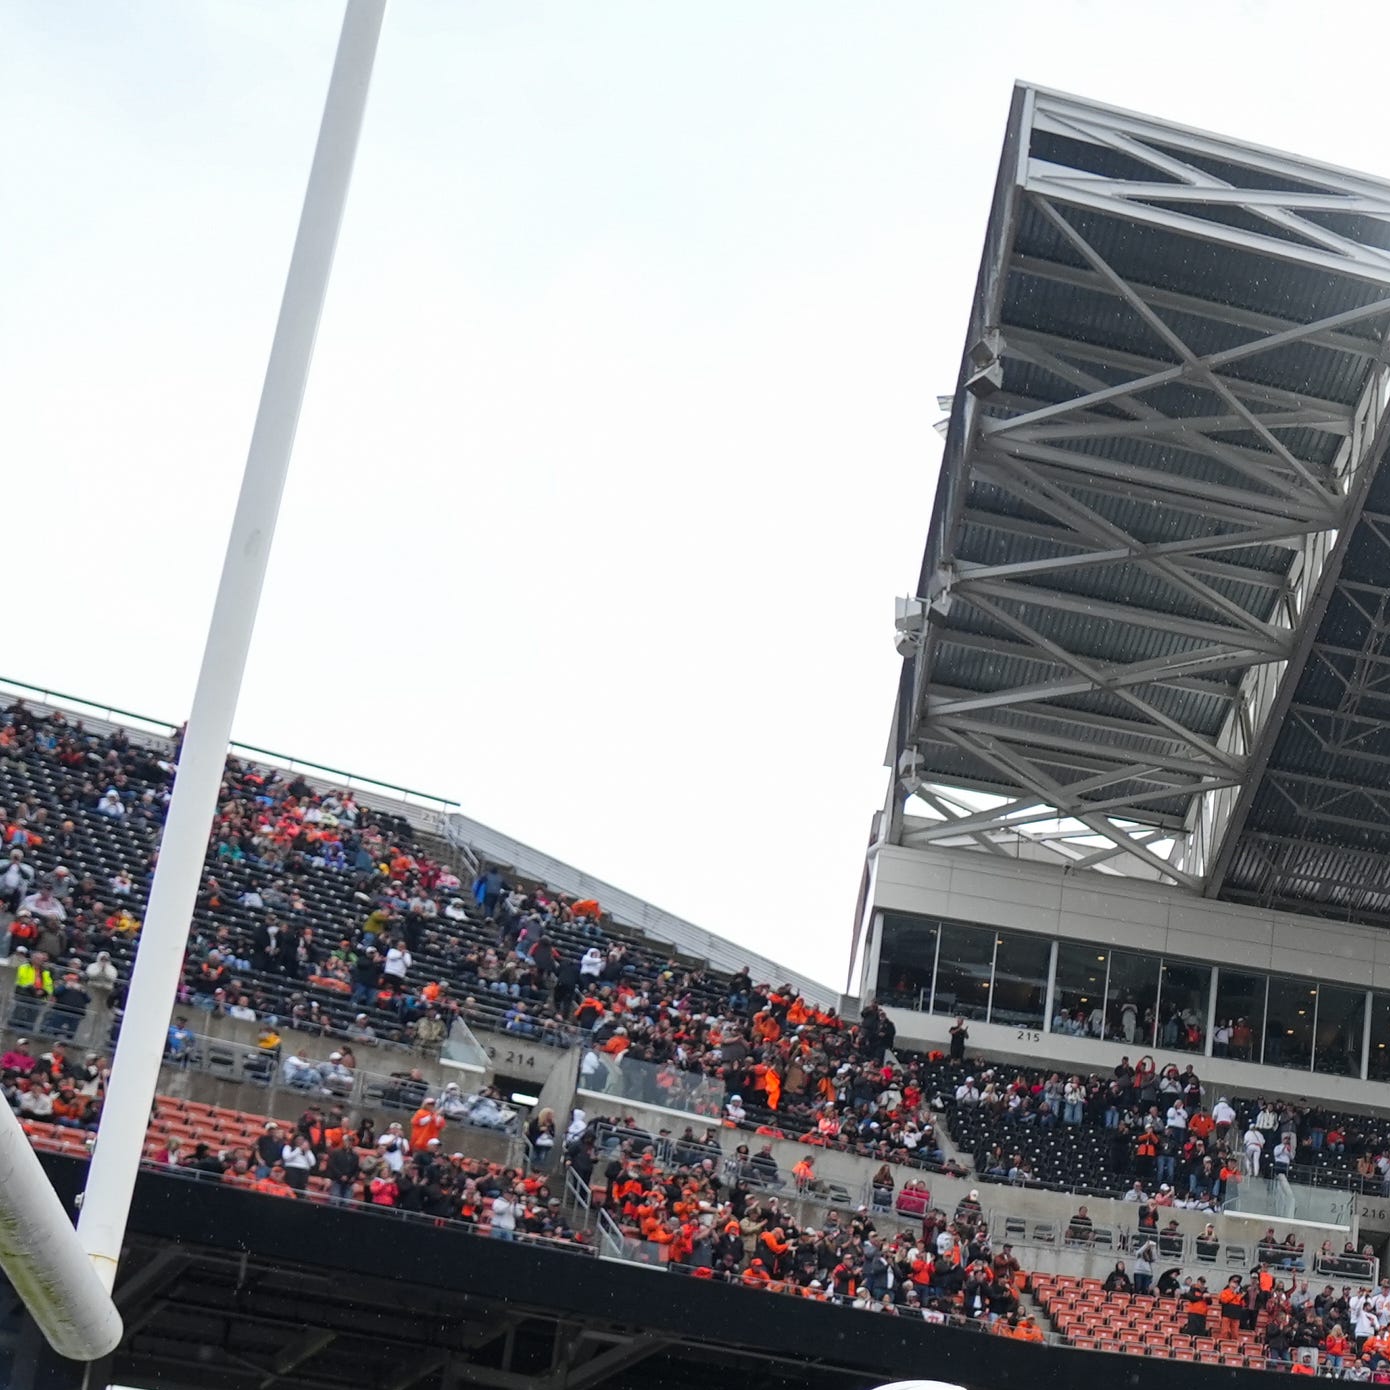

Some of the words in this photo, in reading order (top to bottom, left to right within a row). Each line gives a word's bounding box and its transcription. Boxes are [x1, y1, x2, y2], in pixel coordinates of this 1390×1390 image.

[1017, 1030, 1040, 1042] 215
[505, 1050, 535, 1067] 214
[1361, 1207, 1386, 1220] 216
